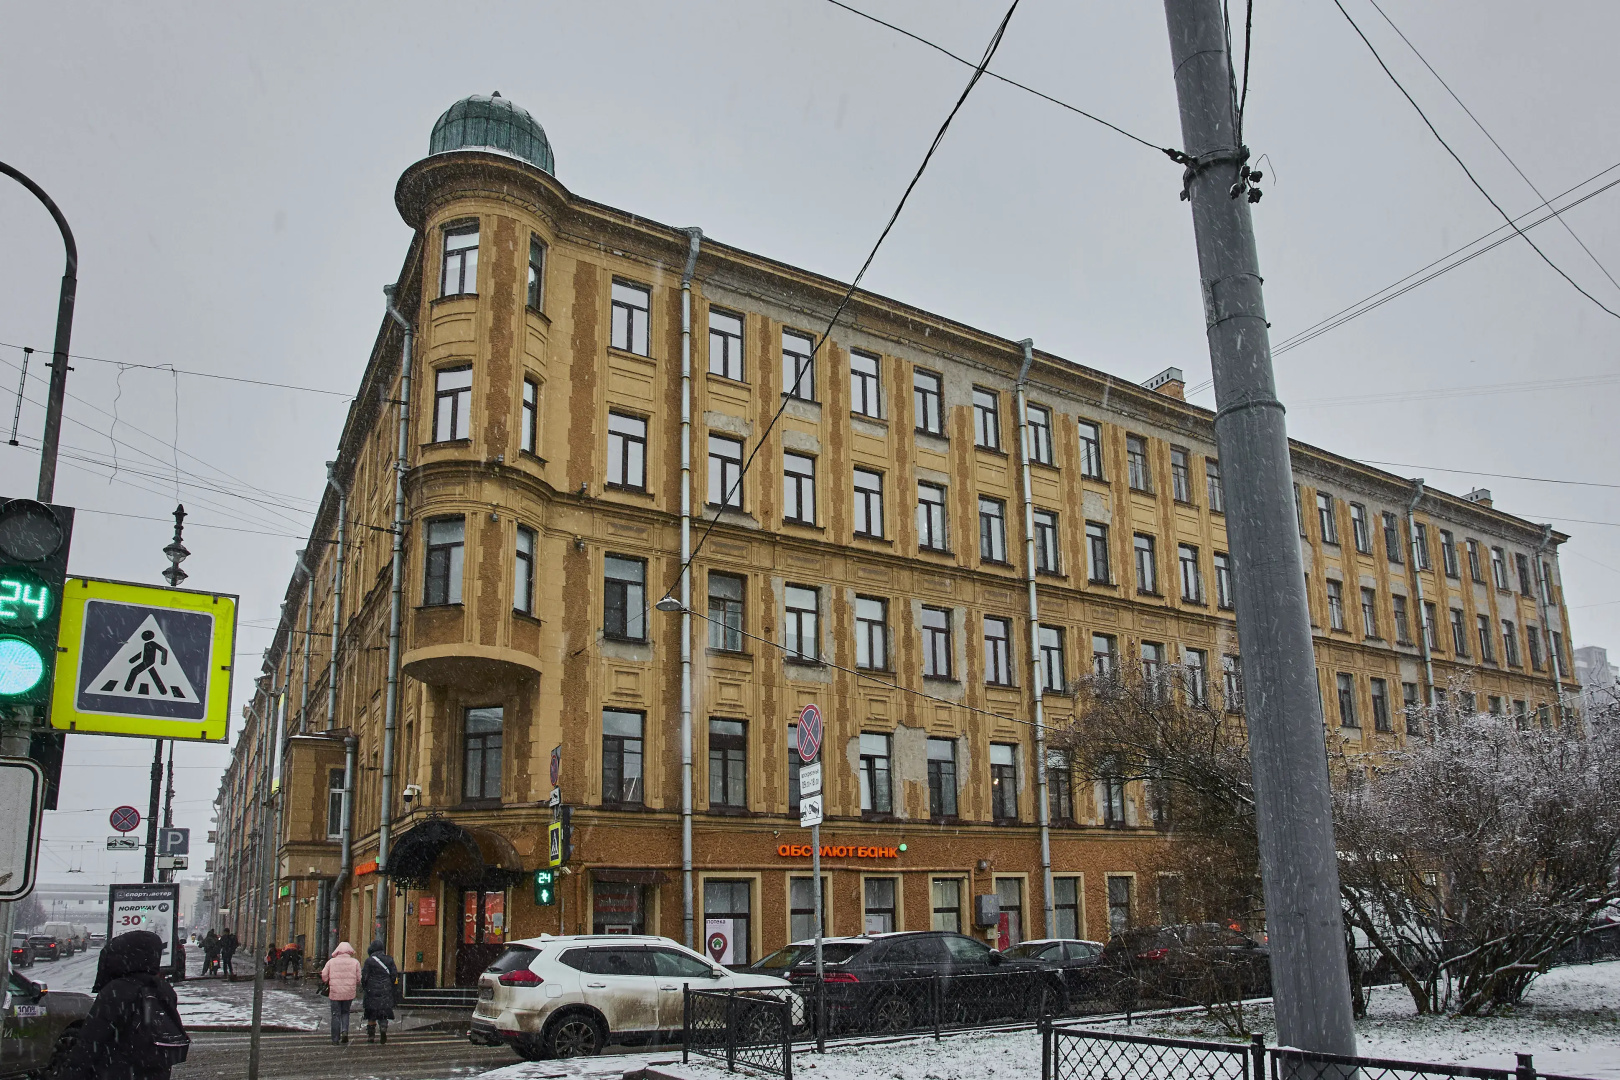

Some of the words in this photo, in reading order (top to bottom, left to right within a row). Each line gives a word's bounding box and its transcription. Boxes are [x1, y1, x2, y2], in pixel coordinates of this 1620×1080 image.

[0, 580, 48, 620] 24
[167, 832, 183, 851] P
[538, 872, 551, 884] 24
